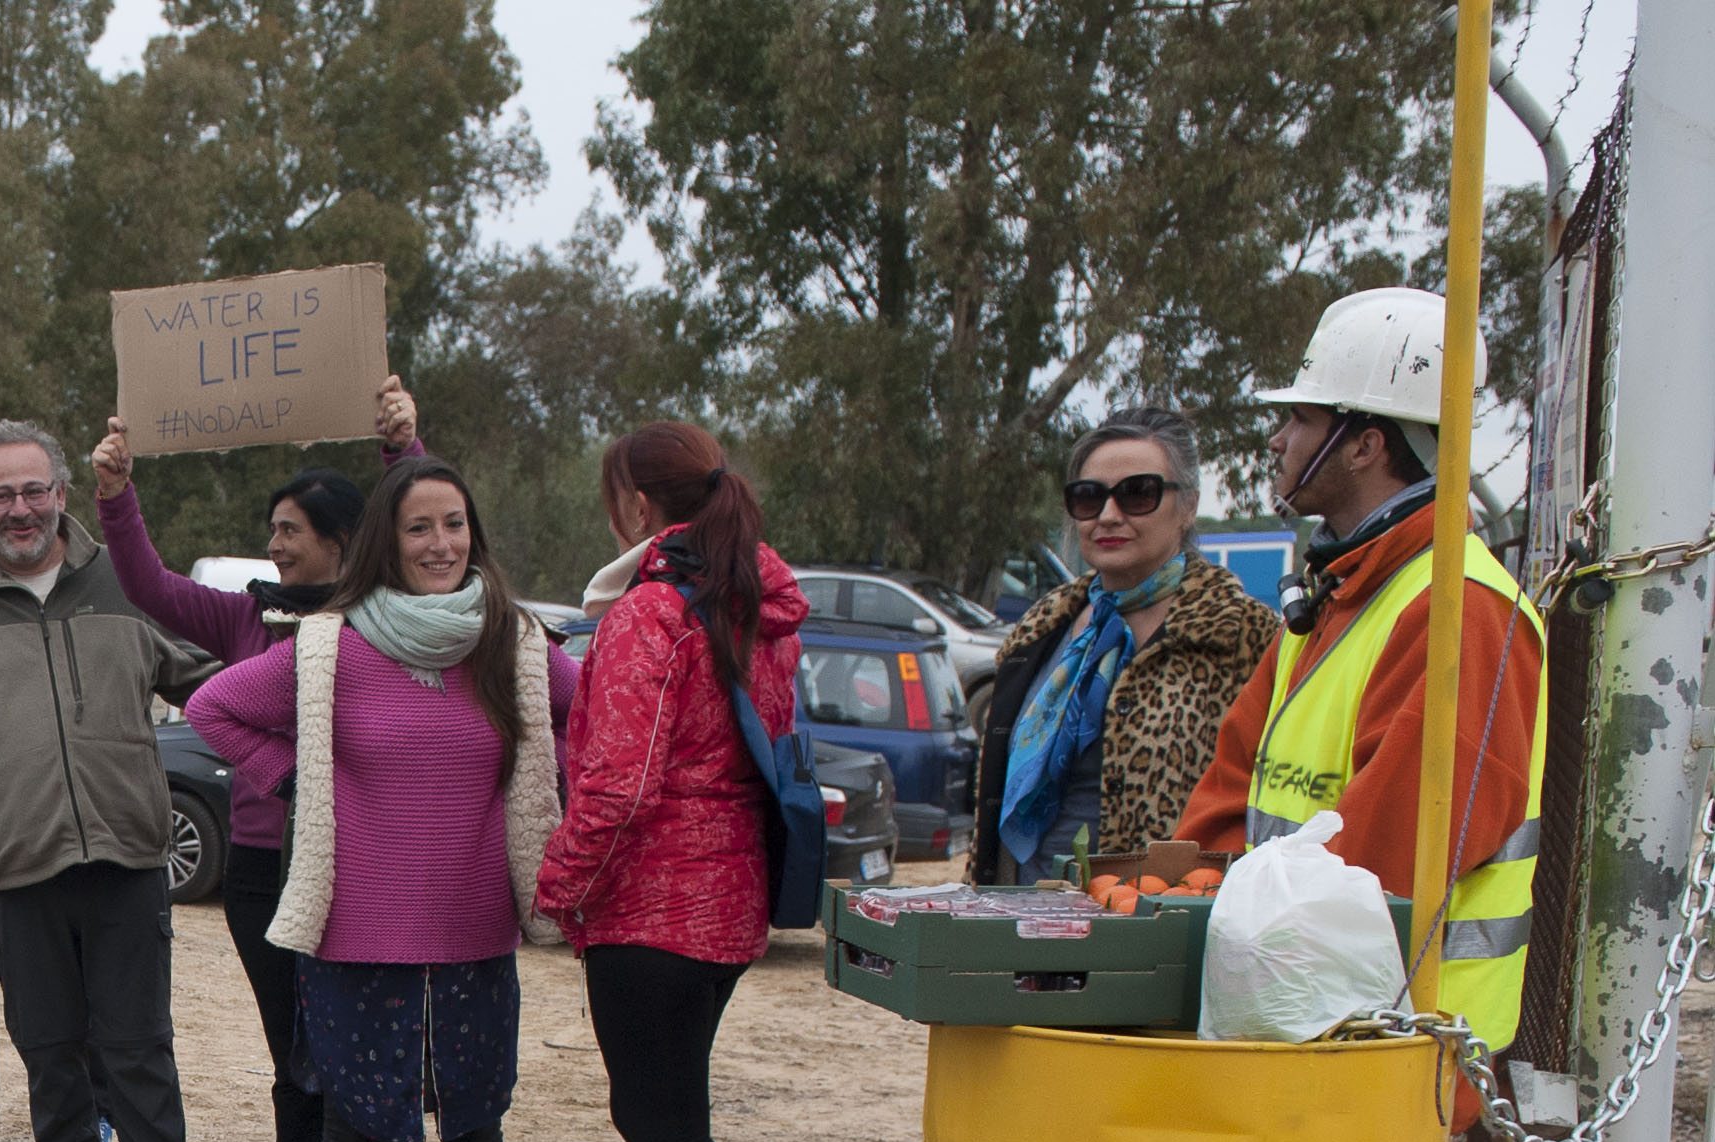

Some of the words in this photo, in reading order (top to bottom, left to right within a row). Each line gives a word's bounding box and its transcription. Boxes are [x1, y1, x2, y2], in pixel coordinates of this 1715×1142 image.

[144, 291, 263, 332] WATER
[294, 287, 320, 318] IS
[198, 328, 303, 386] LIFE
